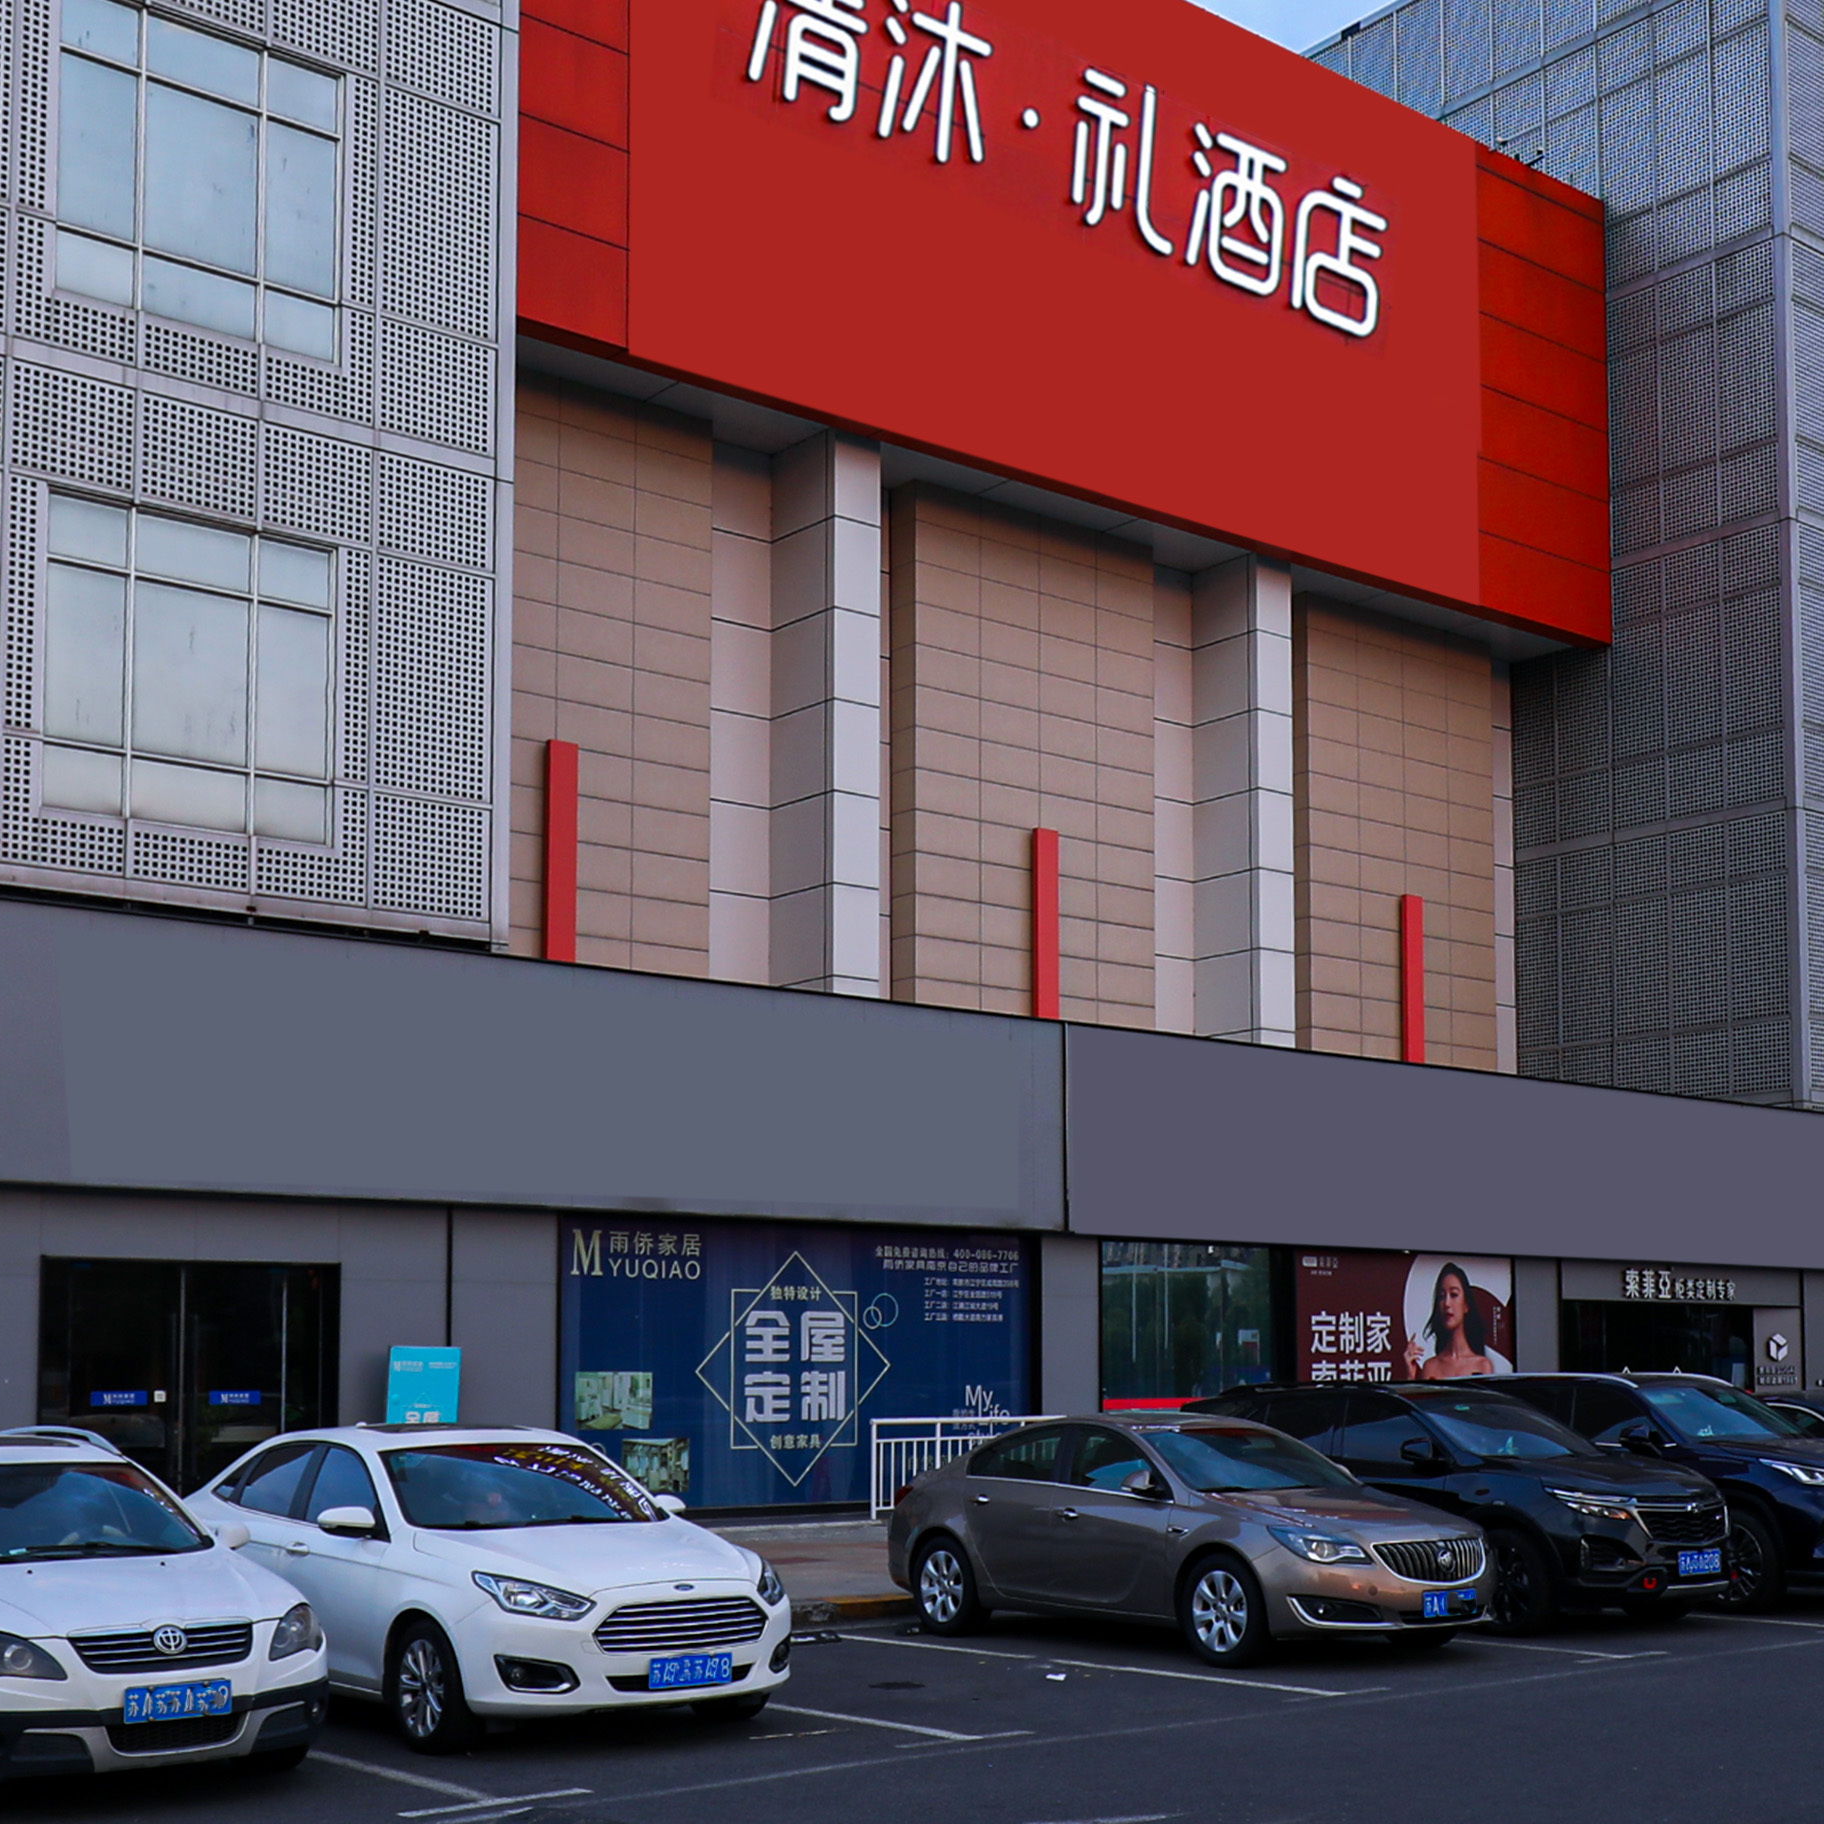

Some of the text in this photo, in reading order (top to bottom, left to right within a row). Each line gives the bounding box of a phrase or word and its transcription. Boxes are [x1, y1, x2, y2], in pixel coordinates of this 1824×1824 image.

[608, 1231, 702, 1257] 雨侨家居
[608, 1258, 702, 1280] YUQIAO
[770, 1285, 822, 1301] 独特设计
[744, 1310, 846, 1362] 全屋
[1310, 1311, 1392, 1355] 定制家
[744, 1370, 846, 1423] 定制
[965, 1384, 994, 1412] My
[770, 1433, 822, 1450] 创意家具
